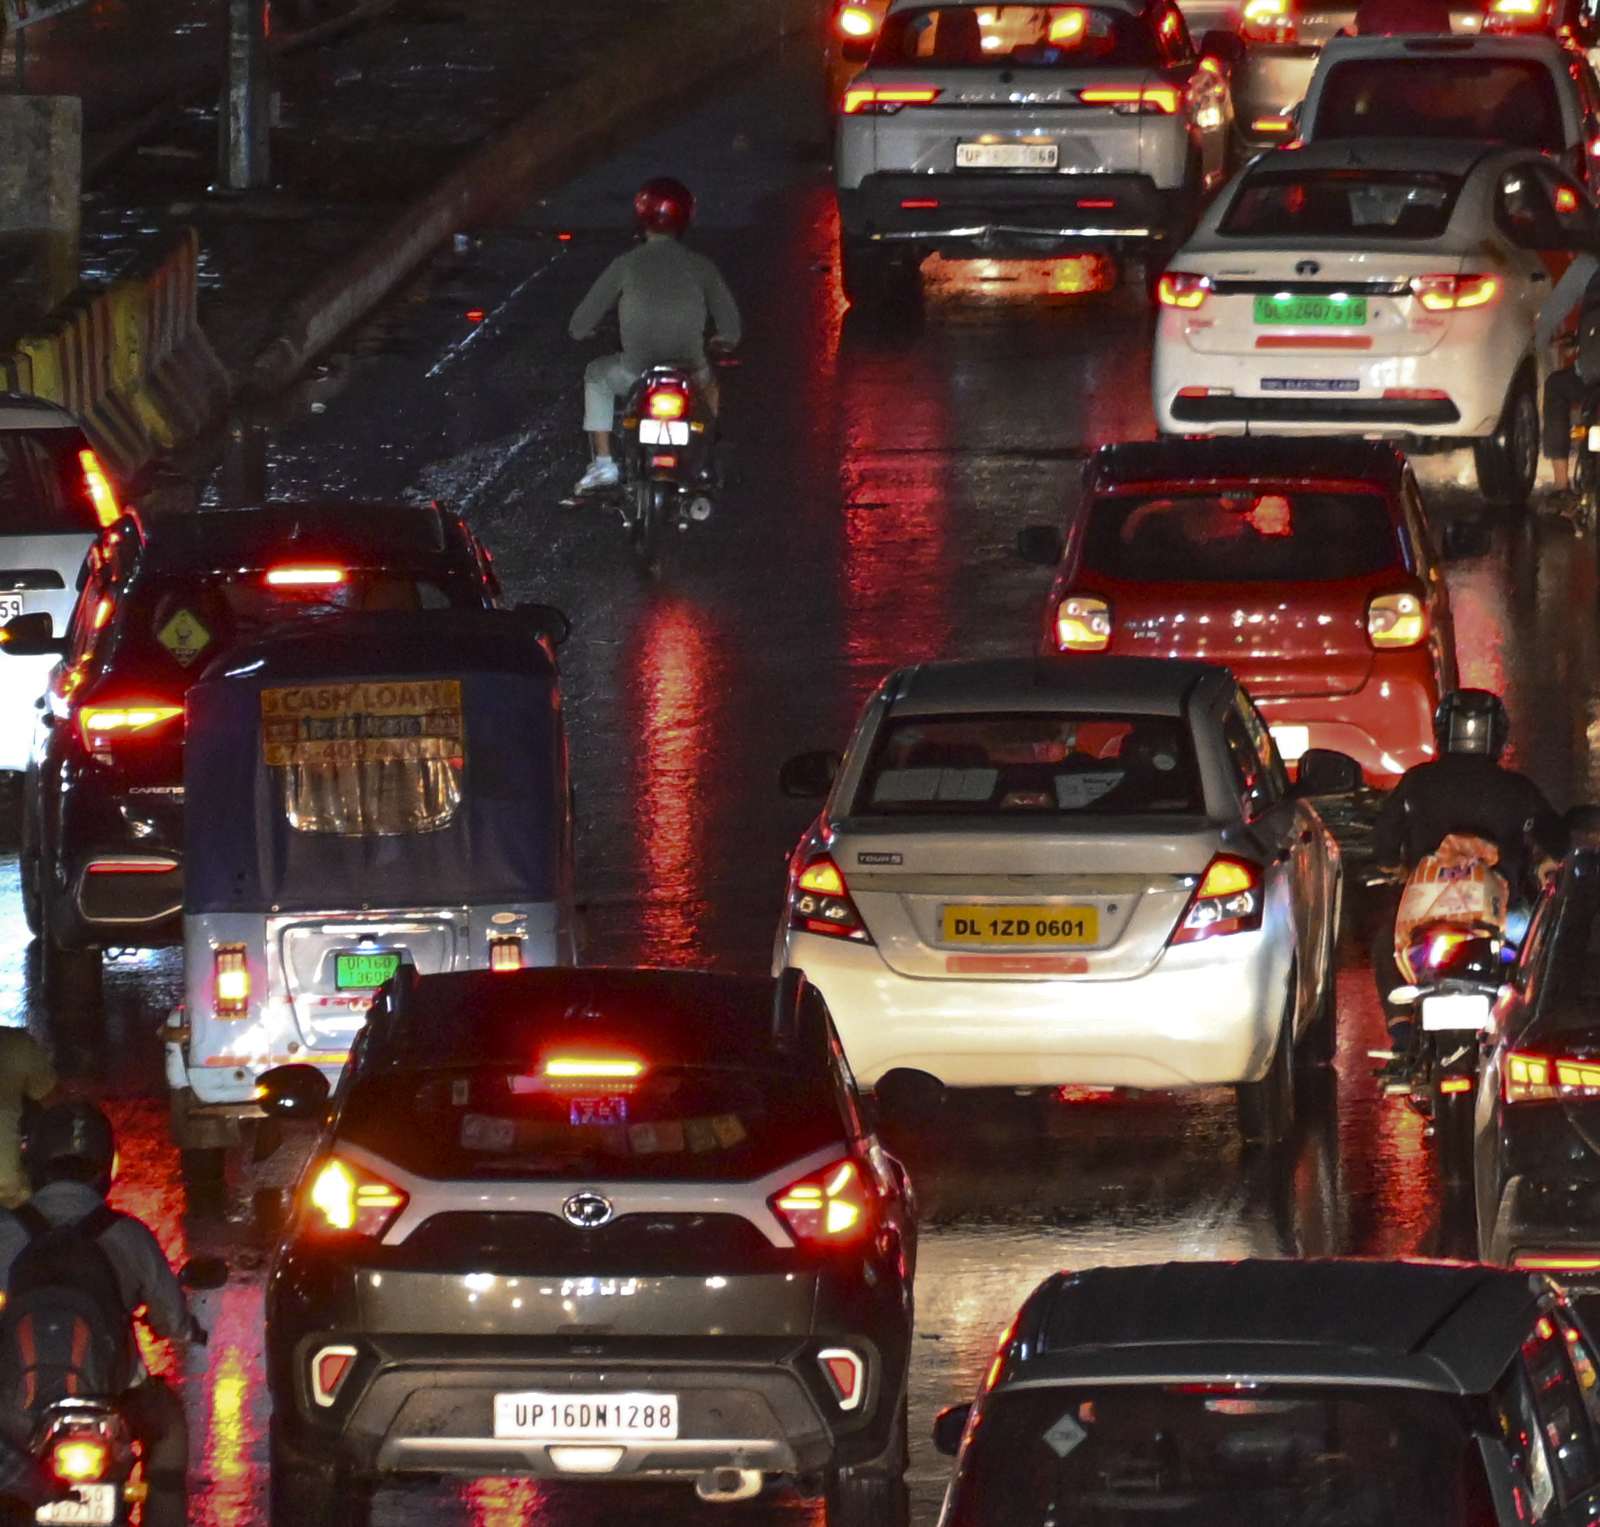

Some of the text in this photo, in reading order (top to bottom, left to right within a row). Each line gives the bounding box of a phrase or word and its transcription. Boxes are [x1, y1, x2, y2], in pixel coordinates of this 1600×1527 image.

[282, 683, 440, 712] CASH LOAN
[954, 919, 1085, 937] DL 1ZD 0601
[515, 1404, 673, 1429] UP16DN1288
